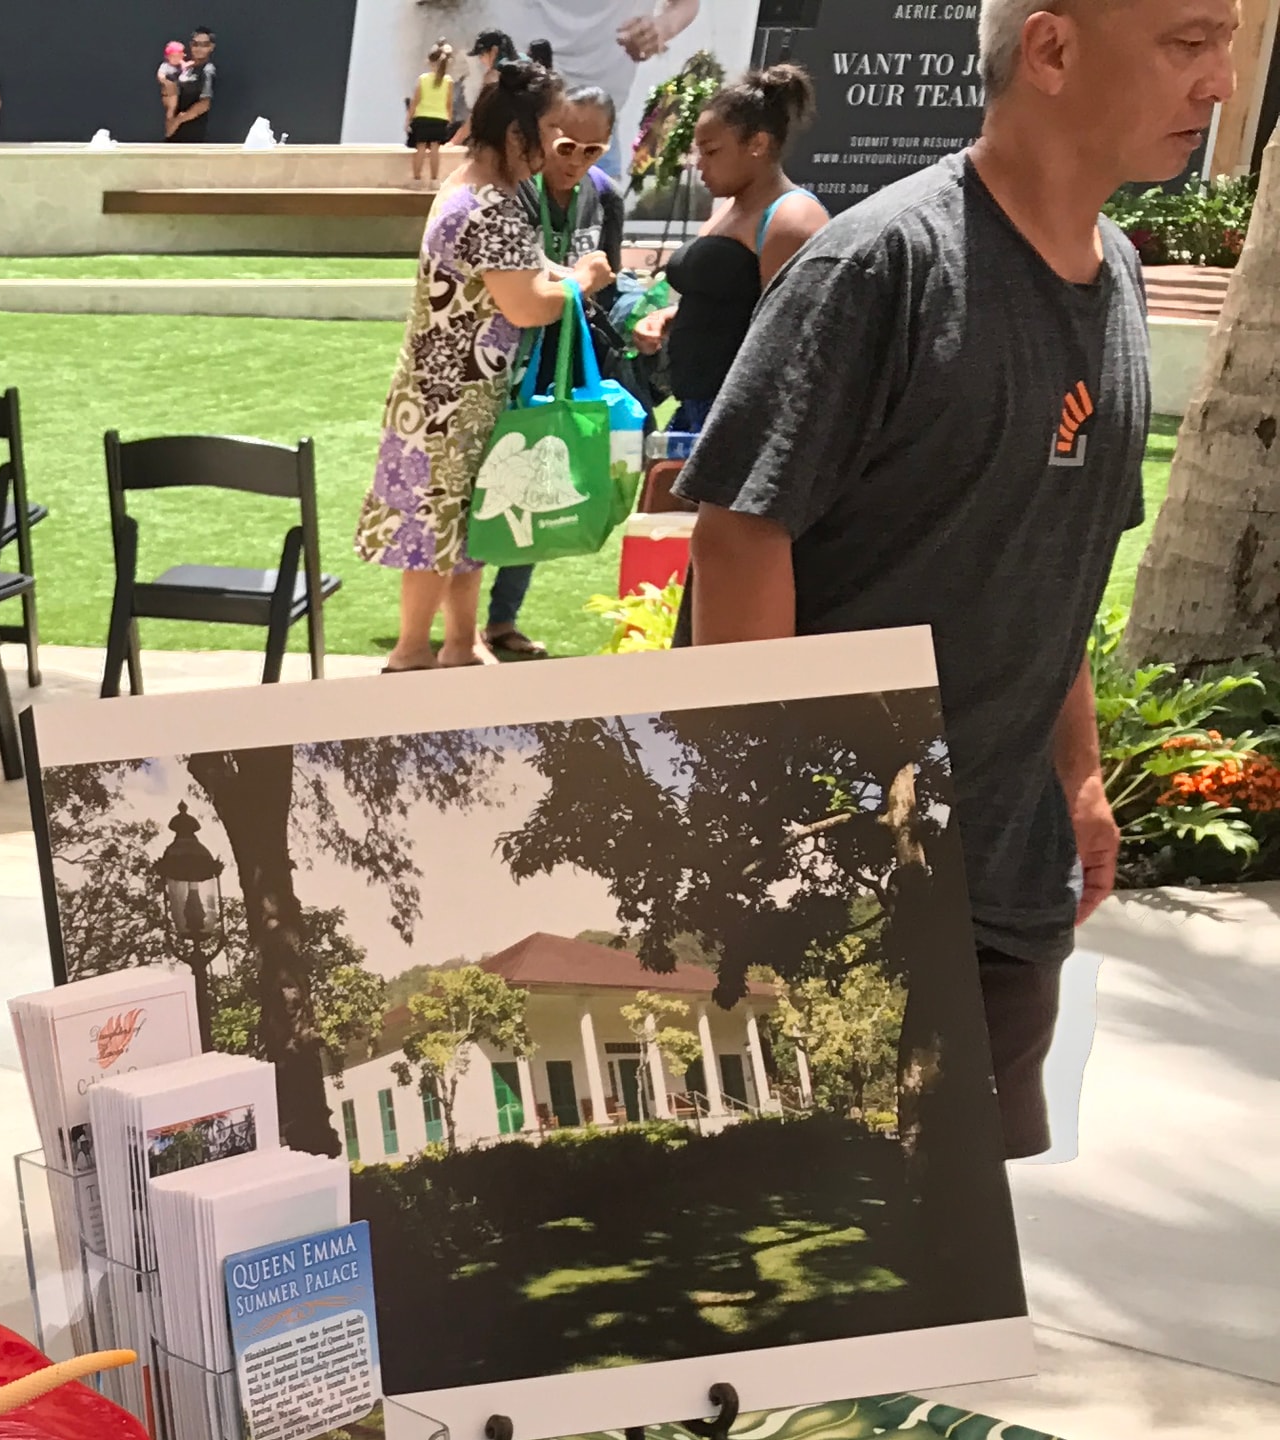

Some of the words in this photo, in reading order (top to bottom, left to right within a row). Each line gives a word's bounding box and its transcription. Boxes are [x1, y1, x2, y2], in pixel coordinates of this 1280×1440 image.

[893, 4, 977, 20] AERIE.COM
[832, 53, 912, 76] WANT
[919, 53, 954, 76] TO
[847, 84, 904, 106] OUR
[914, 84, 986, 107] TEAM
[850, 136, 889, 147] SUBMIT
[892, 137, 920, 147] YOUR
[923, 138, 964, 148] RESUME
